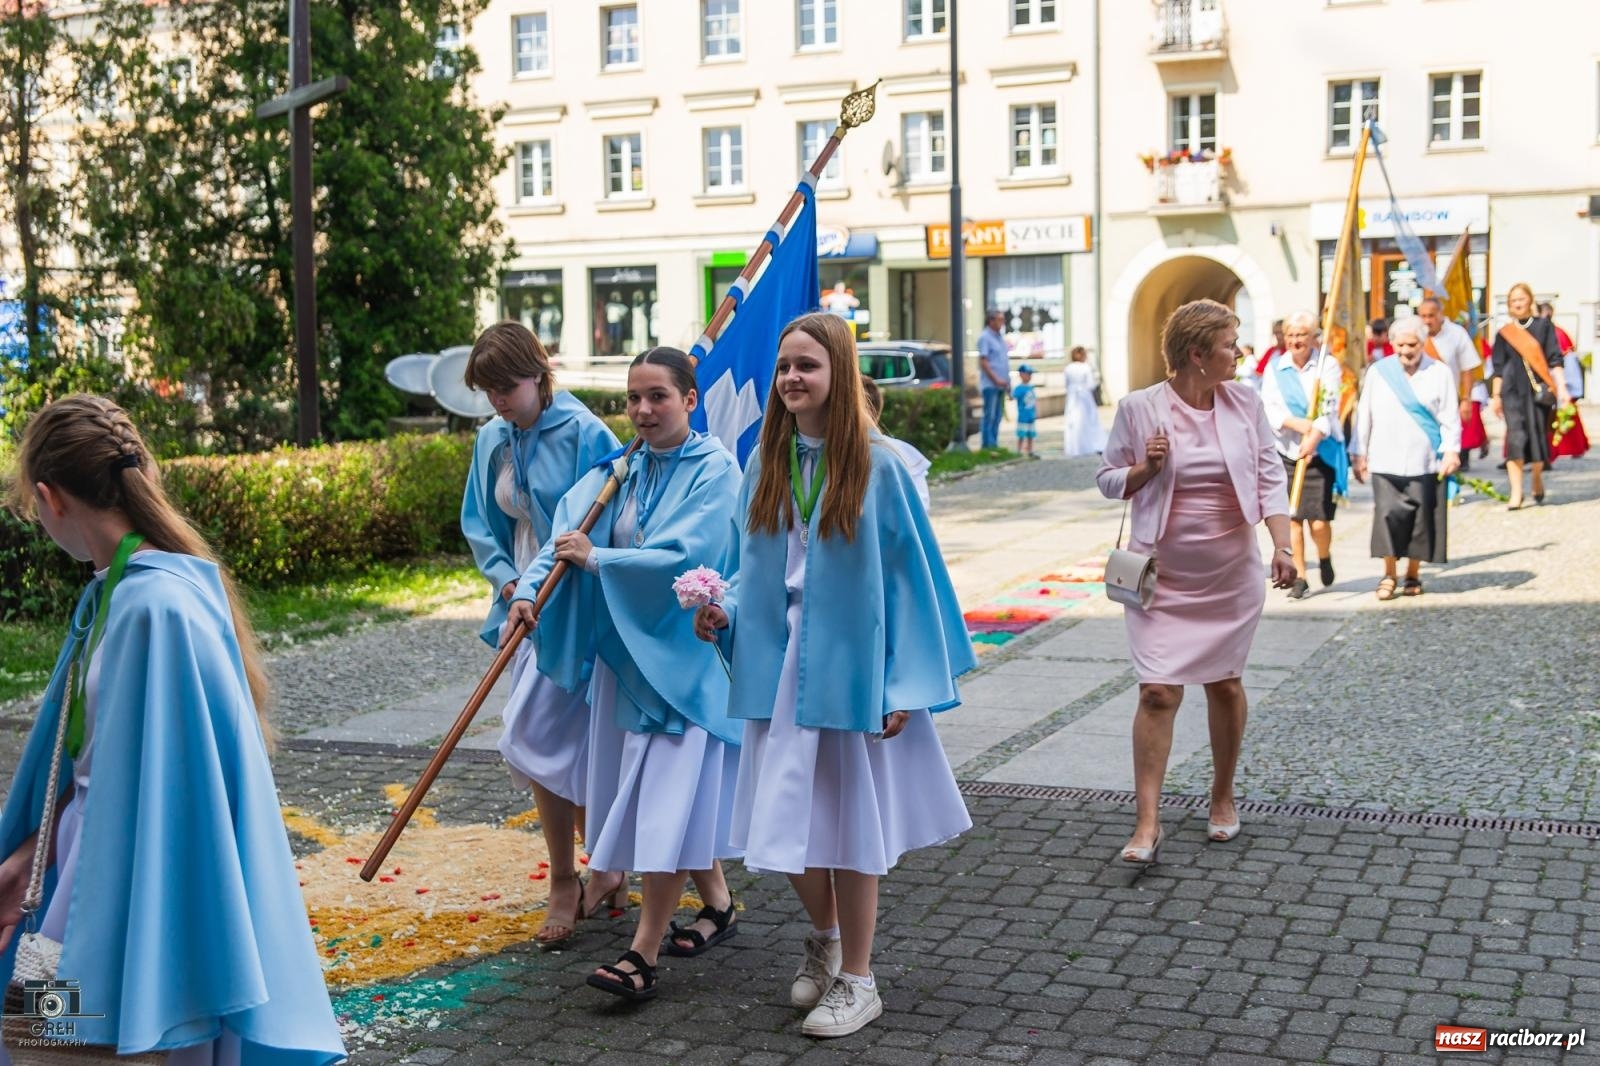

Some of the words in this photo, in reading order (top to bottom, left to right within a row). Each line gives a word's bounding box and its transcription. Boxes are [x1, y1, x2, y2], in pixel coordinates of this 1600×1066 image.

[1373, 209, 1449, 223] RANBOW
[931, 226, 1005, 246] FIANY
[1010, 223, 1075, 241] SZYCIE
